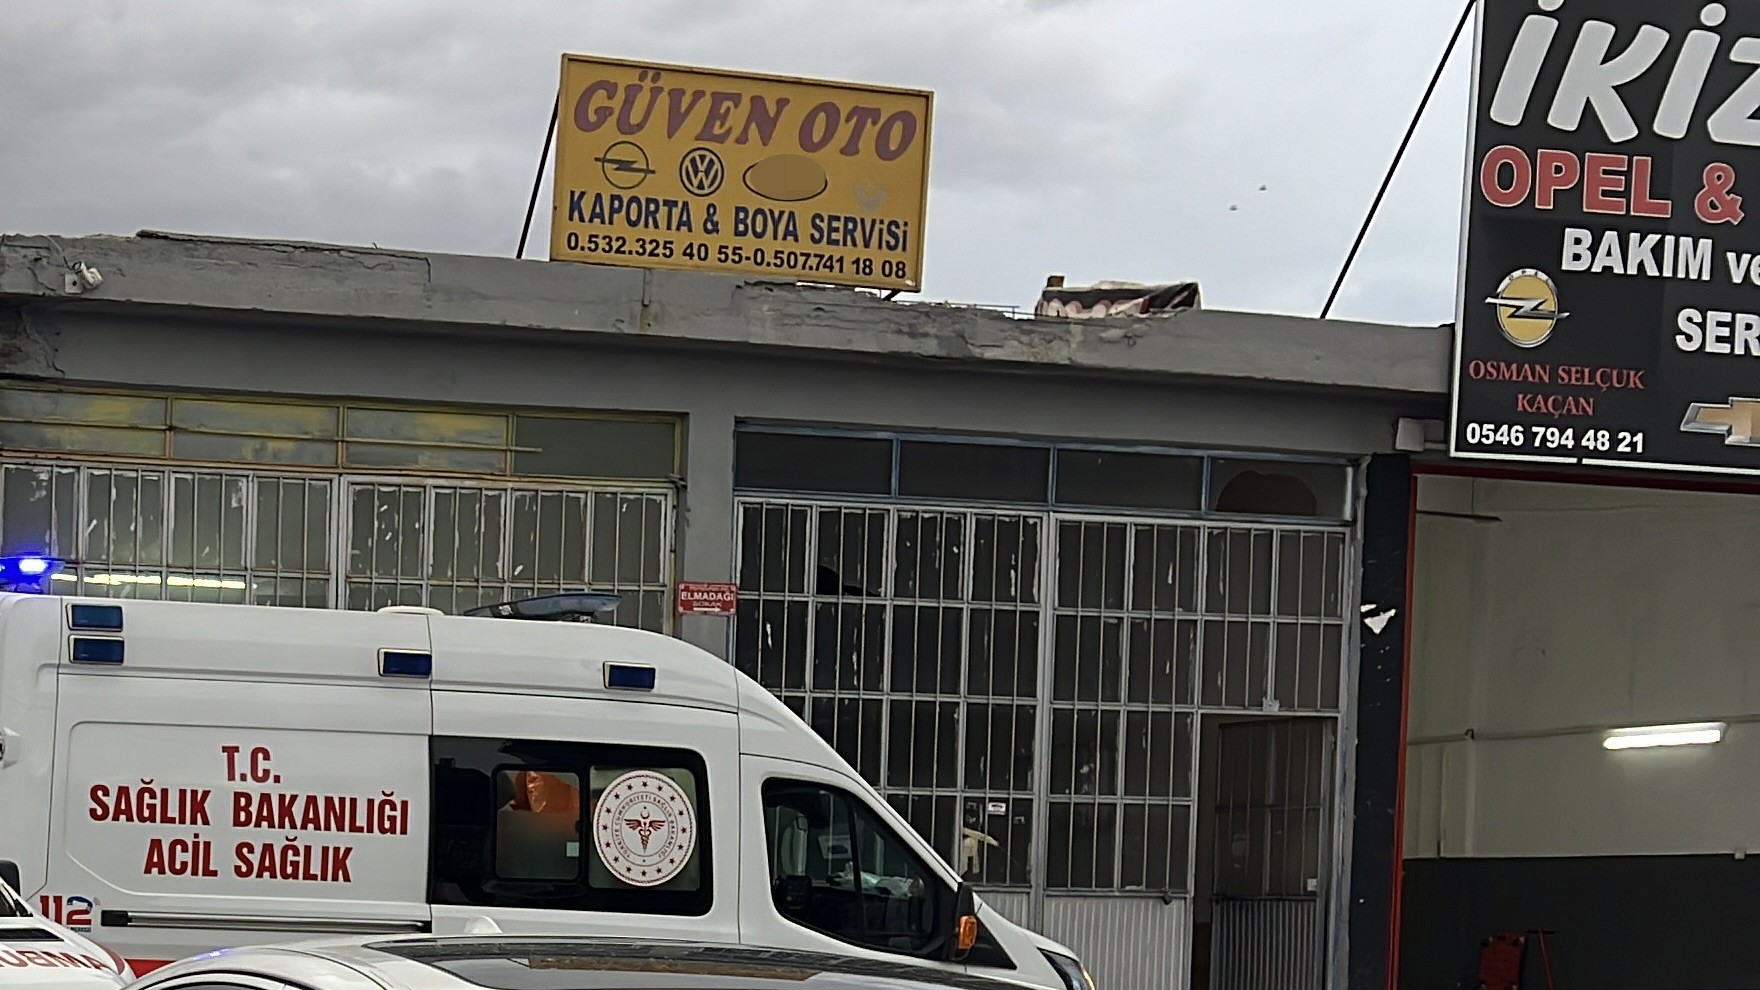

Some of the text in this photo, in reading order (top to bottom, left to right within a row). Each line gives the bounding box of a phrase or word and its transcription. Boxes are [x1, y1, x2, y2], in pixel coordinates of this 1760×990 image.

[573, 70, 918, 162] GÜVEN OTO
[1480, 145, 1745, 225] OPEL &
[567, 190, 693, 233] KAPORTA
[703, 203, 720, 235] &
[734, 205, 799, 242] BOYA
[567, 232, 674, 259] 0.532.325
[682, 242, 709, 261] 40
[852, 258, 874, 276] 18
[881, 260, 908, 279] 08
[1561, 227, 1713, 281] BAKIM
[1469, 359, 1645, 392] OSMAN SELÇUK
[1517, 393, 1594, 419] KAÇAN
[1466, 423, 1645, 453] 0546 794 48 21
[222, 745, 281, 784] T.C.
[89, 778, 409, 836] SAĞLIK BAKANLIĞI
[144, 832, 352, 883] ACİL SAĞLIK
[40, 895, 93, 925] 112
